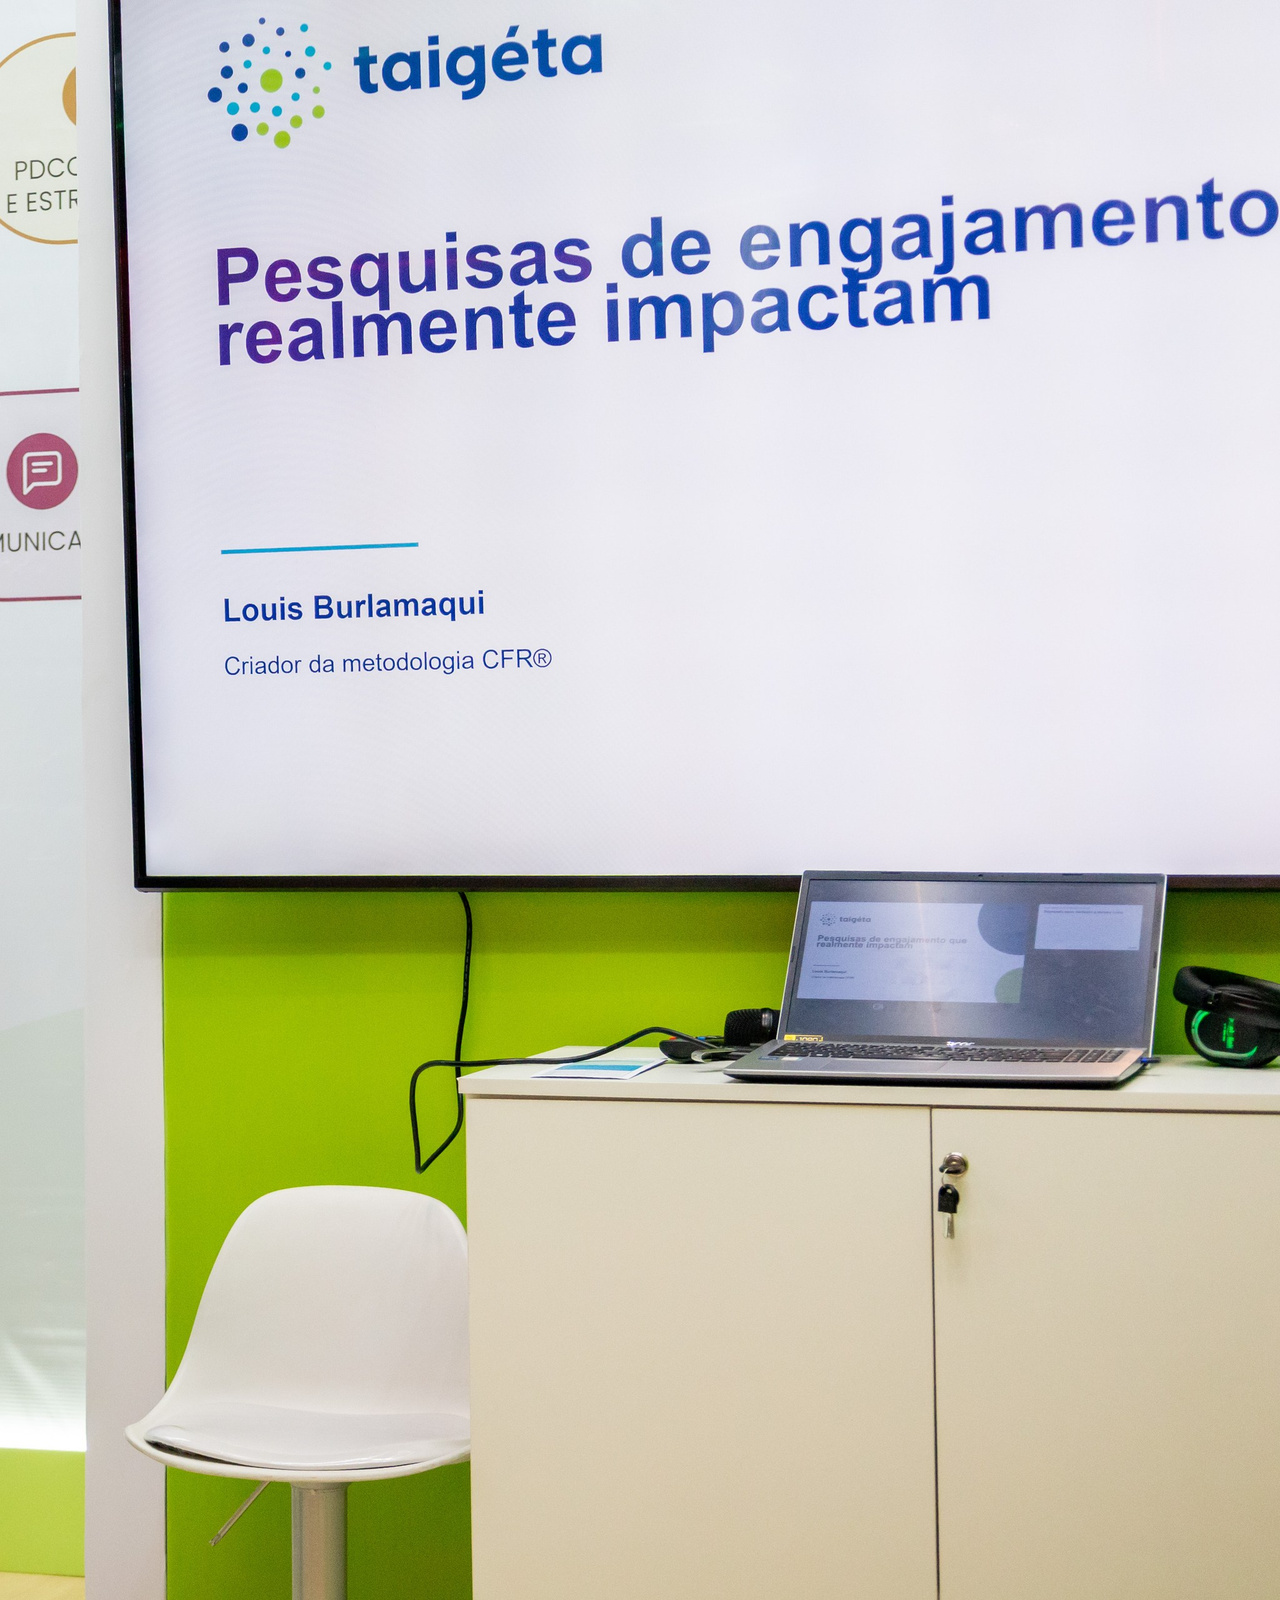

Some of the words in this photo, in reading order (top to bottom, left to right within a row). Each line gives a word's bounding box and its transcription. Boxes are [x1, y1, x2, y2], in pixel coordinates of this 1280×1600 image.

[353, 25, 603, 100] taigéta
[7, 194, 18, 213] E
[216, 231, 593, 311] Pesquisas
[621, 216, 712, 279] de
[739, 176, 1280, 281] engajamento
[218, 289, 577, 366] realmente
[605, 266, 991, 353] impactam
[224, 596, 303, 622] Louis
[313, 590, 485, 622] Burlamaqui
[224, 655, 302, 676] Criador
[308, 654, 335, 673] da
[342, 651, 475, 675] metodologia
